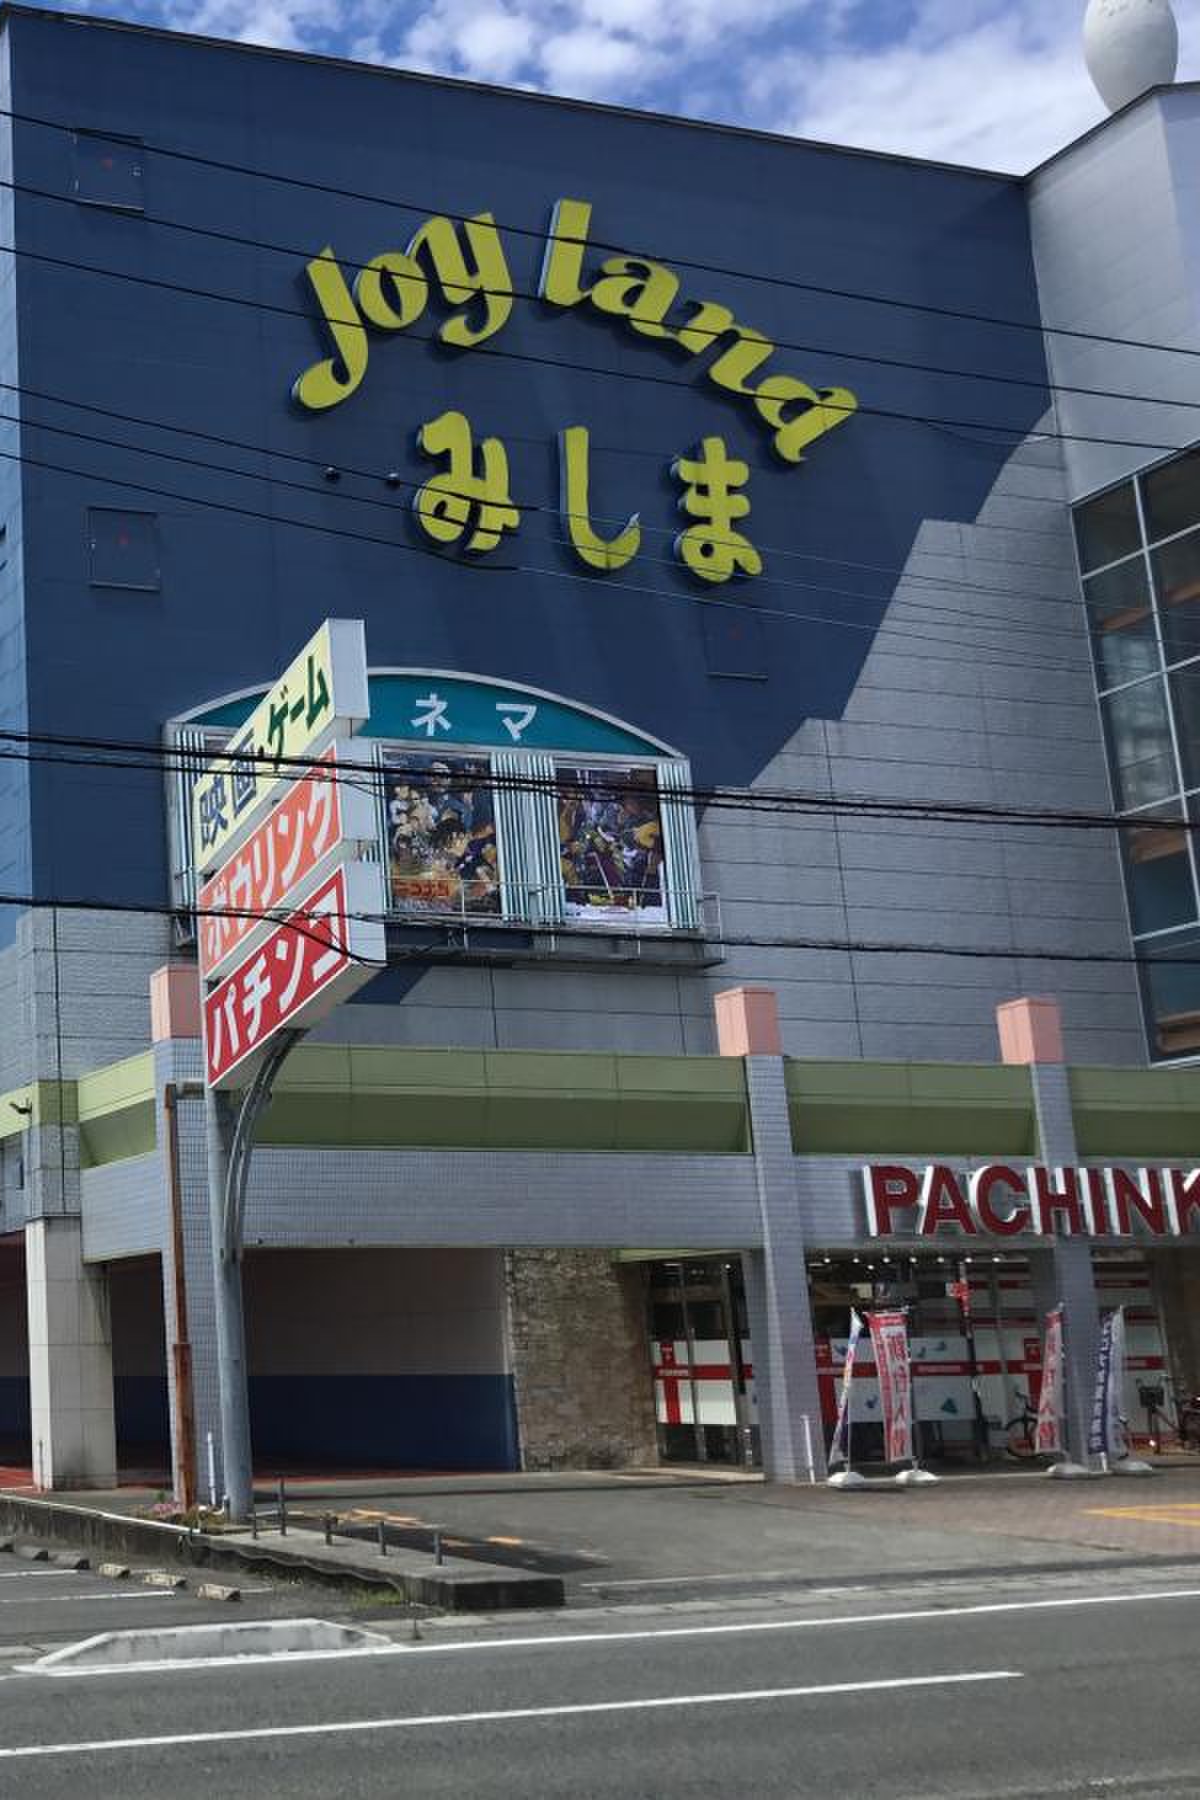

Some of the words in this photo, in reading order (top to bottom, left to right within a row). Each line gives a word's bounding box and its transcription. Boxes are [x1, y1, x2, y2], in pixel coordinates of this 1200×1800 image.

[413, 411, 763, 583] みしま
[211, 887, 342, 1071] パチンコ
